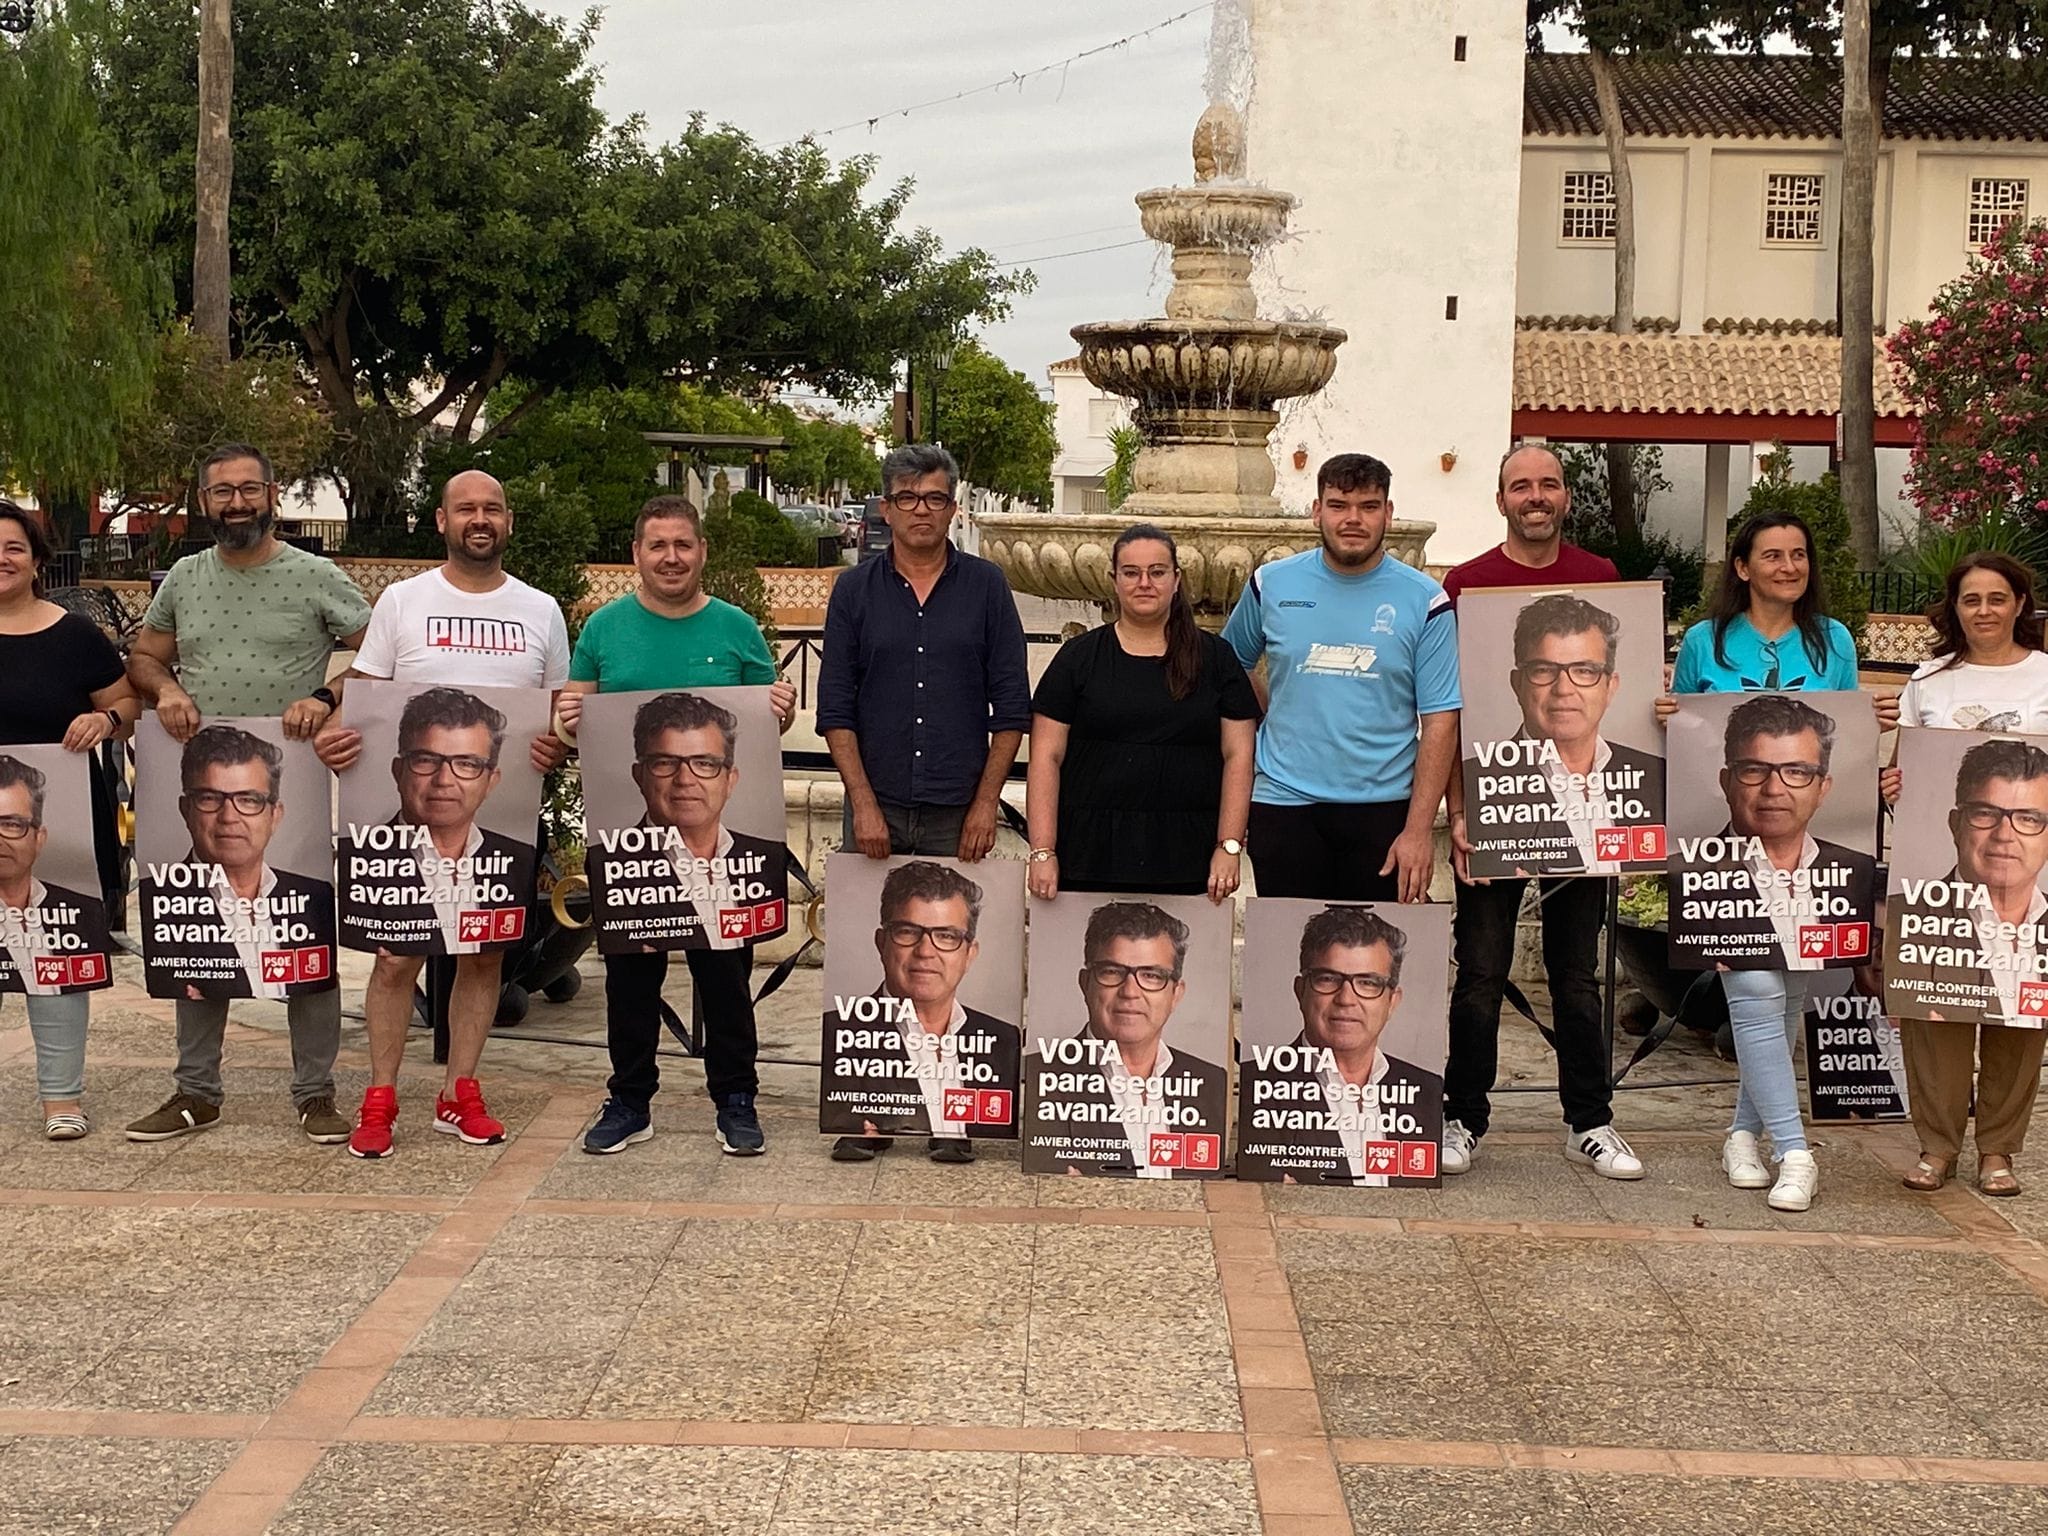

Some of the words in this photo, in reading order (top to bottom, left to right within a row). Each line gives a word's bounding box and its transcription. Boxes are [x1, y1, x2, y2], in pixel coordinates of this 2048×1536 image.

[427, 617, 525, 652] PUMA
[1473, 739, 1562, 768] VOTA
[1478, 774, 1545, 800] para
[1551, 764, 1644, 796] seguir
[1479, 794, 1651, 824] avanzando.
[348, 823, 434, 850] VOTA
[598, 826, 686, 853] VOTA
[1475, 840, 1516, 850] JAVIER
[1599, 834, 1626, 844] PSOE
[1502, 852, 1542, 861] ALCALDE
[1543, 851, 1567, 859] 2023
[1678, 836, 1768, 863] VOTA
[148, 863, 231, 888] VOTA
[350, 856, 416, 879] para
[421, 850, 514, 880] seguir
[604, 858, 670, 884] para
[676, 851, 766, 880] seguir
[1683, 870, 1750, 896] para
[1756, 862, 1853, 892] seguir
[350, 878, 514, 905] avanzando.
[607, 878, 772, 906] avanzando.
[1901, 878, 1993, 911] VOTA
[153, 895, 215, 919] para
[220, 889, 310, 916] seguir
[1682, 891, 1857, 919] avanzando.
[344, 914, 382, 930] JAVIER
[462, 916, 490, 926] PSOE
[603, 920, 643, 931] JAVIER
[722, 913, 749, 923] PSOE
[1901, 913, 1972, 938] para
[154, 919, 316, 943] avanzando.
[366, 932, 407, 941] ALCALDE
[408, 932, 431, 942] 2023
[629, 931, 668, 939] ALCALDE
[669, 929, 693, 937] 2023
[1676, 935, 1718, 944] JAVIER
[1802, 931, 1831, 941] PSOE
[264, 956, 292, 967] PSOE
[1702, 948, 1744, 956] ALCALDE
[1745, 947, 1769, 956] 2023
[38, 962, 64, 971] PSOE
[150, 958, 189, 968] JAVIER
[174, 970, 212, 978] ALCALDE
[212, 971, 236, 979] 2023
[1890, 978, 1934, 991] JAVIER
[834, 995, 919, 1022] VOTA
[1813, 996, 1885, 1020] VOTA
[1916, 995, 1961, 1006] ALCALDE
[1962, 998, 1987, 1008] 2023
[836, 1029, 901, 1052] para
[906, 1029, 997, 1057] seguir
[1818, 1028, 1872, 1050] para
[1038, 1038, 1124, 1065] VOTA
[1253, 1045, 1339, 1072] VOTA
[834, 1057, 999, 1082] avanzando.
[1039, 1072, 1104, 1096] para
[1110, 1071, 1203, 1099] seguir
[1254, 1079, 1320, 1104] para
[1325, 1079, 1420, 1107] seguir
[1816, 1086, 1850, 1095] JAVIER
[827, 1091, 868, 1102] JAVIER
[947, 1095, 973, 1105] PSOE
[851, 1106, 892, 1114] ALCALDE
[892, 1107, 915, 1116] 2023
[1038, 1100, 1206, 1126] avanzando.
[1252, 1108, 1423, 1134] avanzando.
[1030, 1136, 1071, 1146] JAVIER
[1152, 1140, 1179, 1150] PSOE
[1245, 1144, 1286, 1155] JAVIER
[1055, 1151, 1095, 1159] ALCALDE
[1097, 1152, 1120, 1161] 2023
[1271, 1158, 1311, 1167] ALCALDE
[1313, 1161, 1337, 1169] 2023
[1369, 1148, 1396, 1157] PSOE
